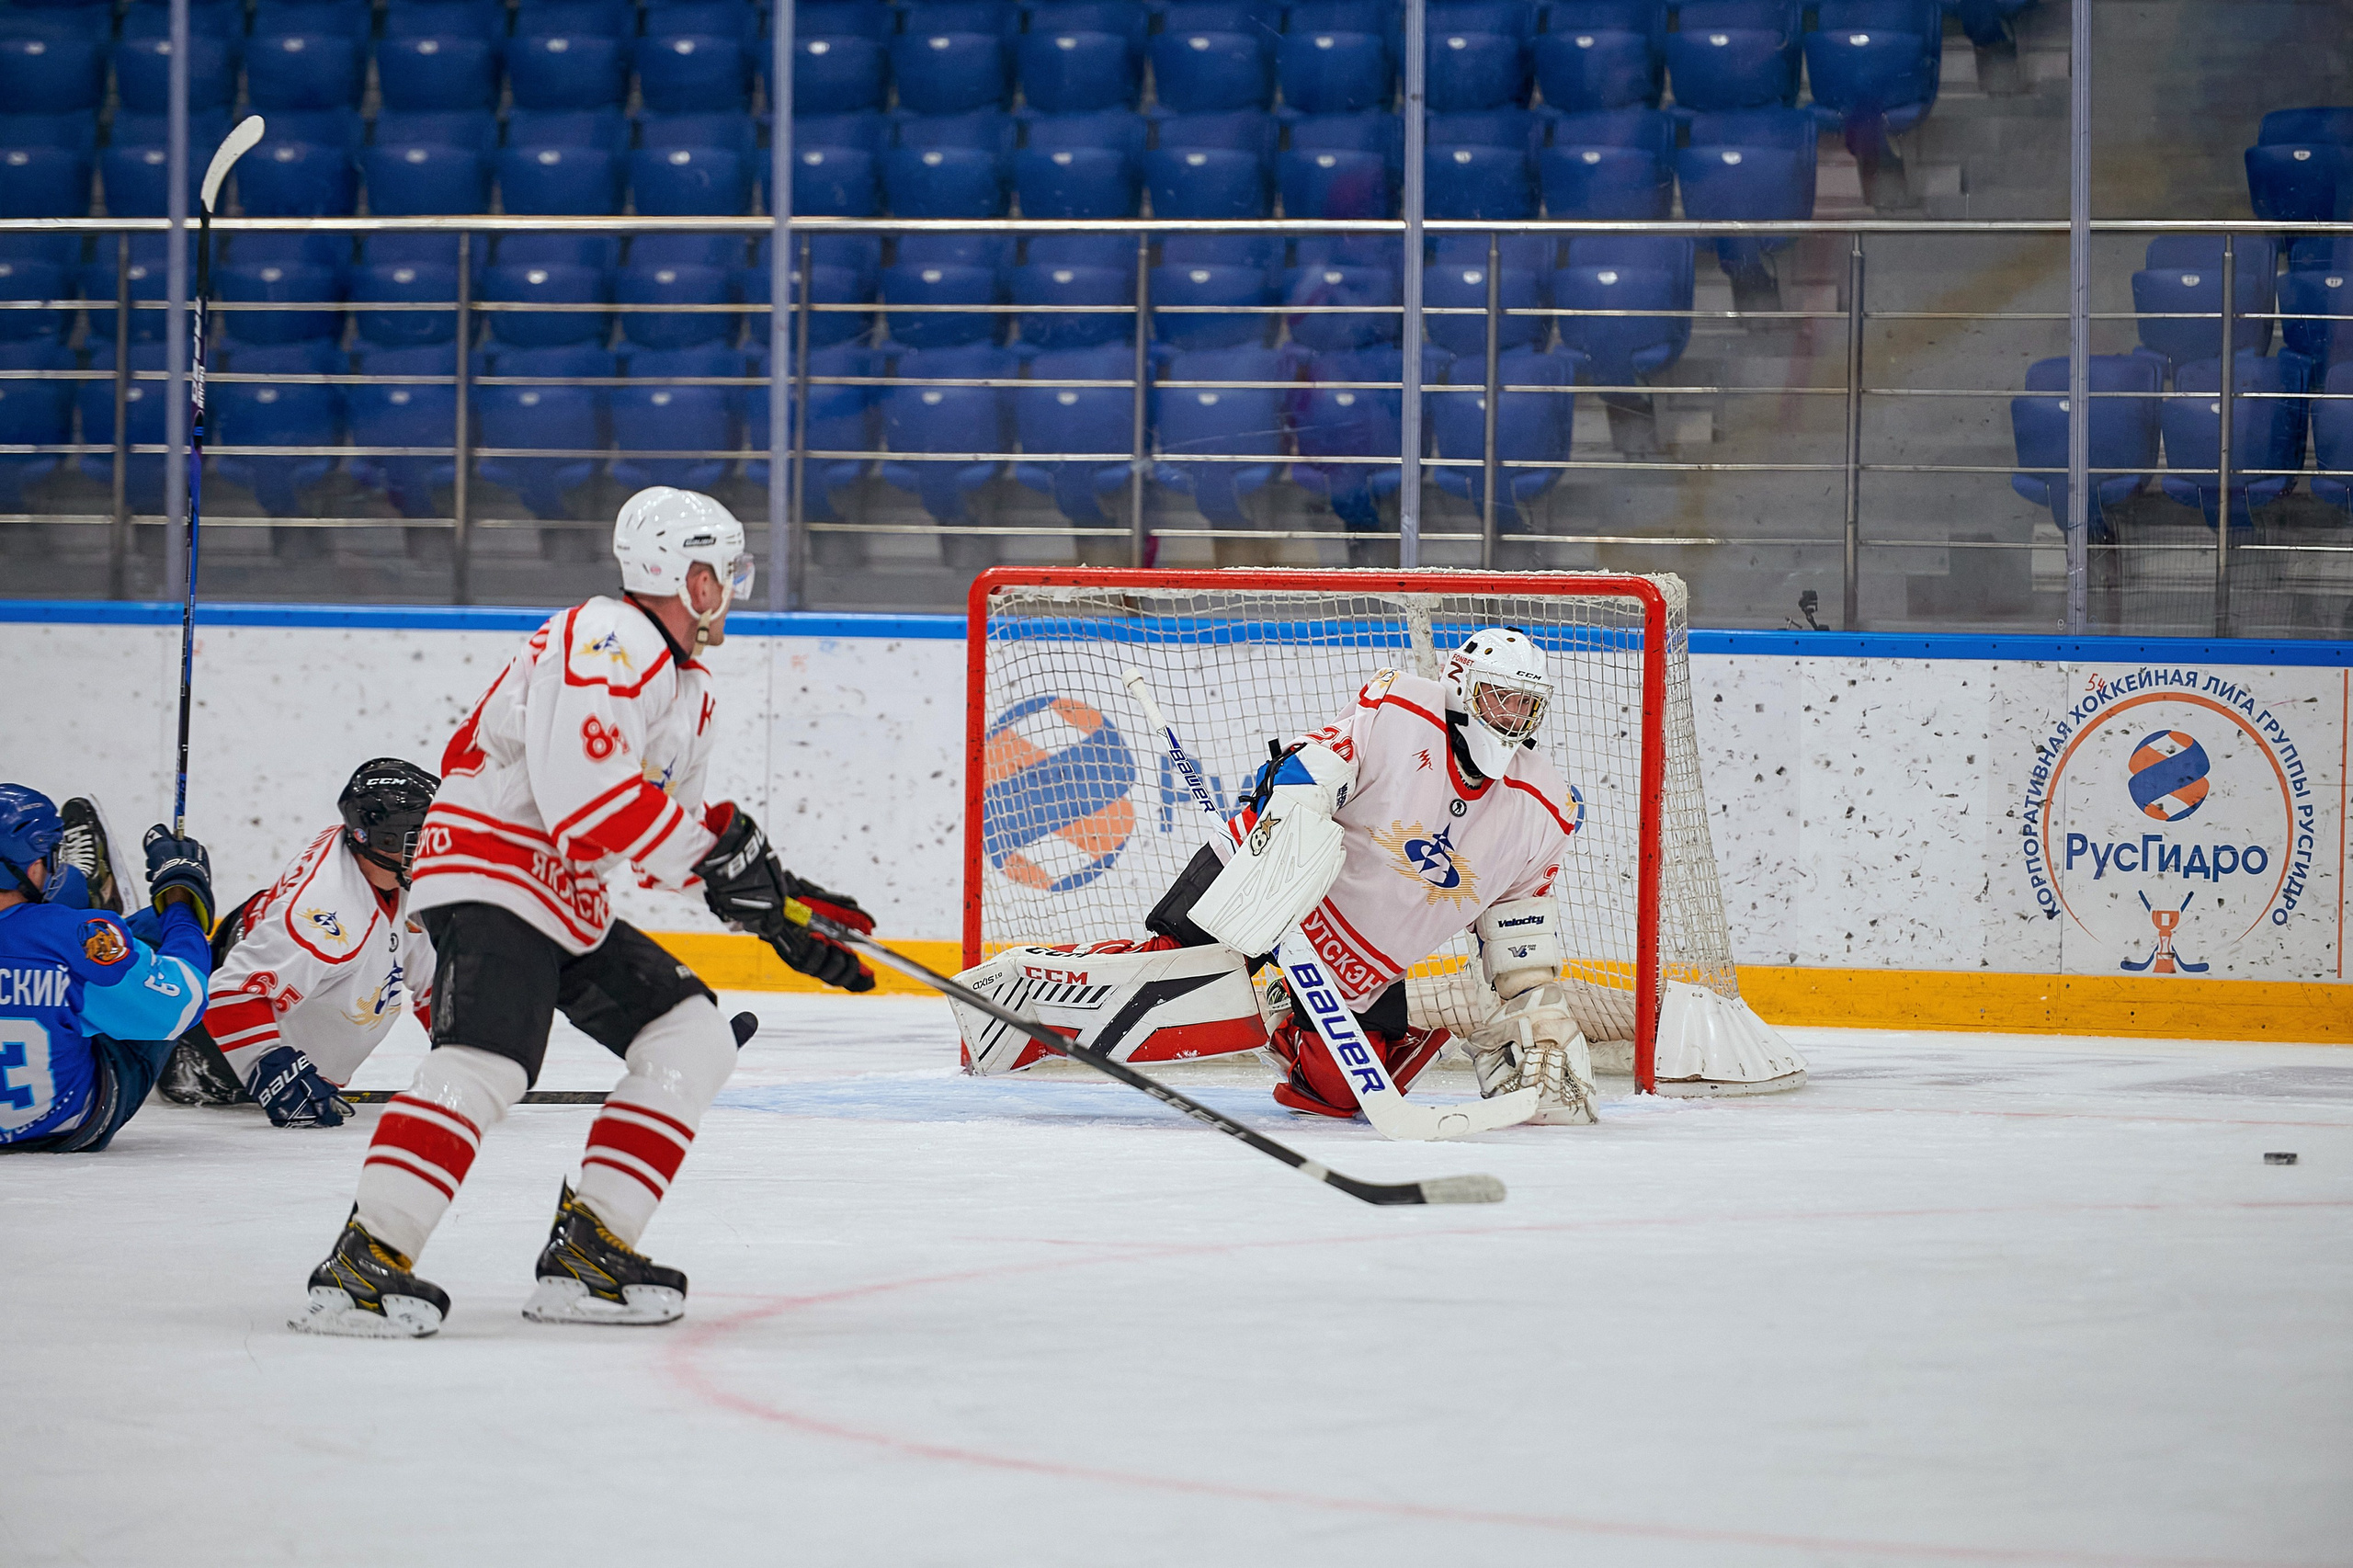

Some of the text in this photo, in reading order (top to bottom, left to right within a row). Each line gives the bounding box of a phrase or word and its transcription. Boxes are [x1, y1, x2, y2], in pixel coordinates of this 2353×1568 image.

[1452, 653, 1474, 667] FONBET
[1516, 670, 1542, 681] CCM
[367, 778, 407, 786] CCM
[1168, 748, 1216, 813] BAUER
[2023, 667, 2314, 926] КОРПОРАТИВНАЯ ХОККЕЙНАЯ ЛИГА ГРУППЫ РУСГИДРО
[2066, 832, 2269, 883] РусГидро
[1497, 915, 1545, 928] Velocity
[239, 971, 304, 1013] 65
[1023, 965, 1088, 985] CCM
[1289, 962, 1386, 1095] BAUER
[0, 1017, 56, 1132] 3
